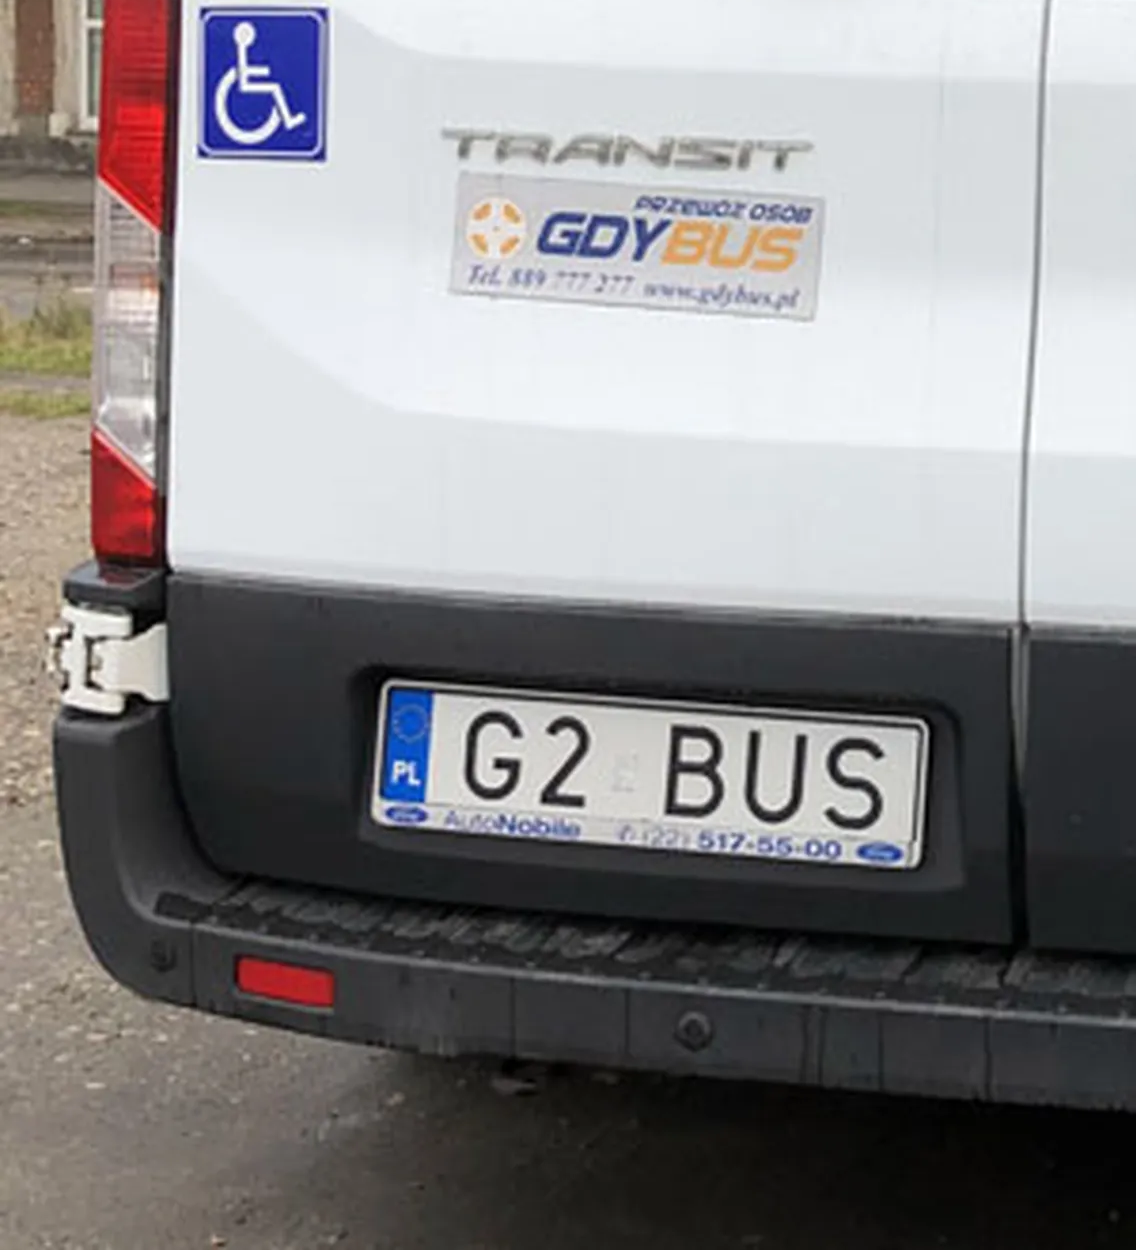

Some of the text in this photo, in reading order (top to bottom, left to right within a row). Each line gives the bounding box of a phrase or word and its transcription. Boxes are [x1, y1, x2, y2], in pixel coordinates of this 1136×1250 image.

[441, 127, 814, 172] TRANSIT
[537, 211, 804, 273] GDYBUS
[554, 270, 591, 291] 777
[594, 273, 636, 295] 277
[643, 283, 800, 311] www.gdybus.pl
[390, 760, 421, 786] PL
[463, 710, 886, 831] G2 BUS
[444, 810, 581, 838] AutoNobile
[699, 831, 842, 860] 517-55-00
